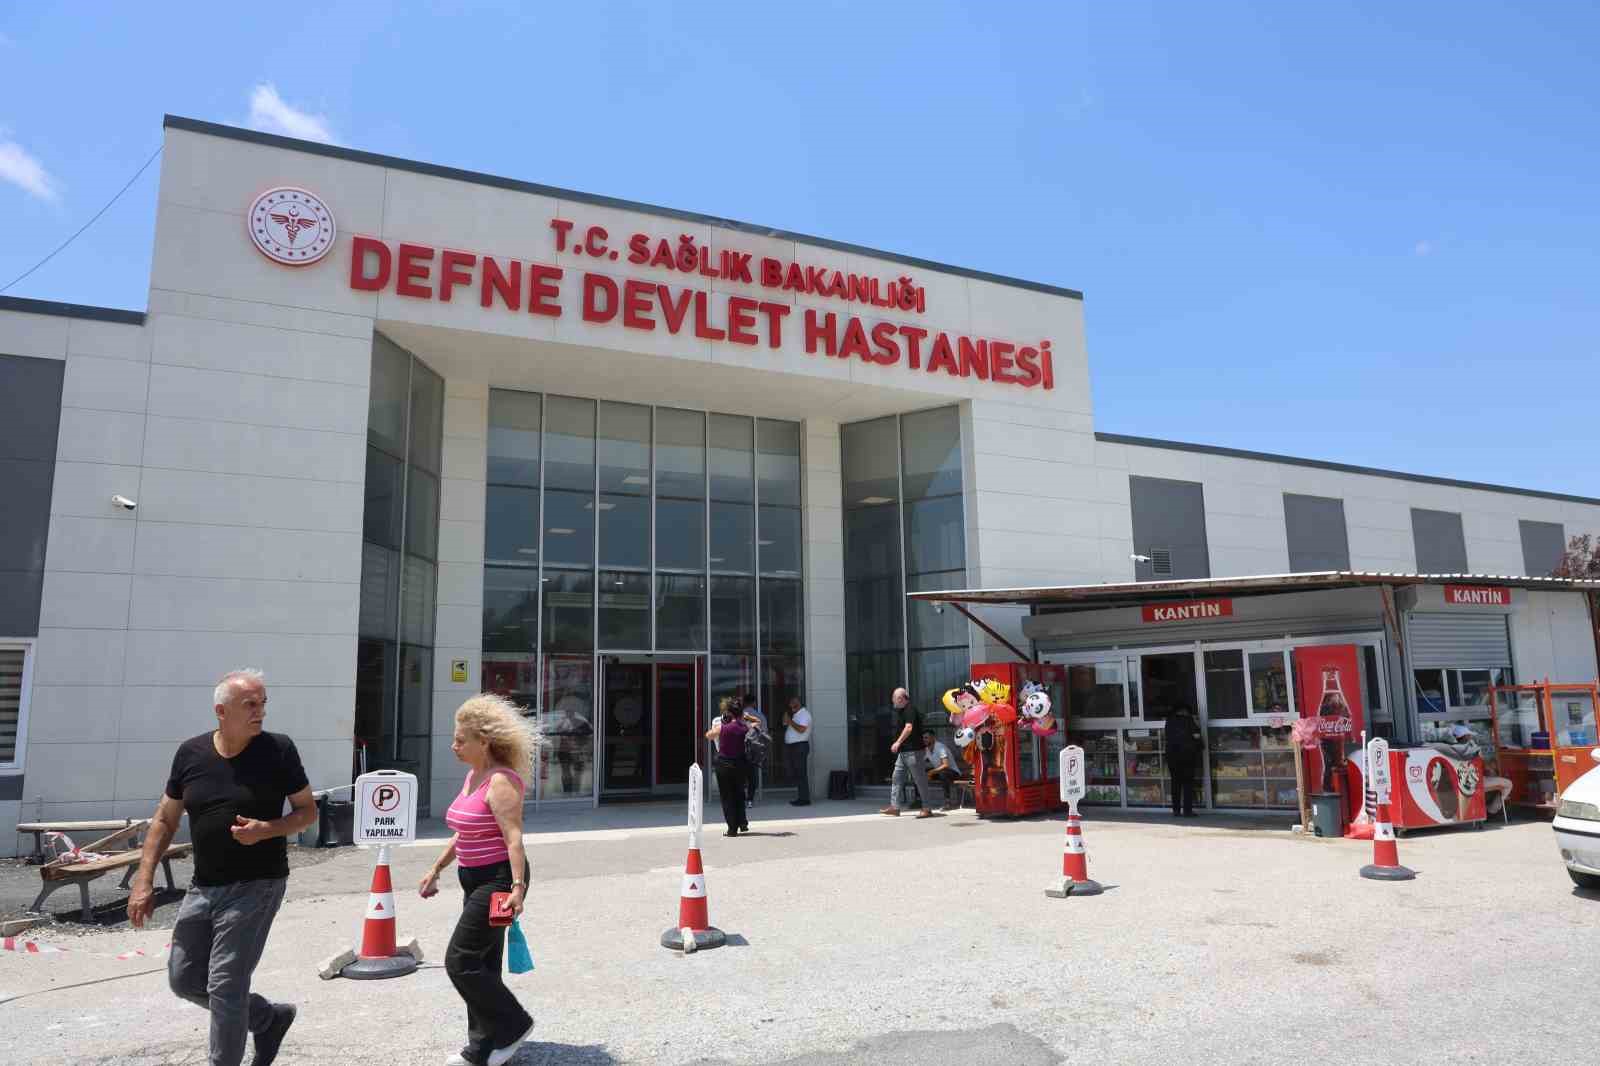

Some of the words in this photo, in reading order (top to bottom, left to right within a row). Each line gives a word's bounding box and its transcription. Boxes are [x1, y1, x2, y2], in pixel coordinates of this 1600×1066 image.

[550, 219, 619, 261] T.C.
[627, 233, 752, 284] SAĞLIK
[760, 255, 926, 314] BAKANLIĞI
[350, 235, 564, 318] DEFNE
[582, 272, 791, 350] DEVLET
[804, 308, 1055, 390] HASTANESİ
[1453, 588, 1502, 604] KANTİN
[1153, 602, 1220, 620] KANTİN
[375, 817, 395, 825] PARK
[365, 828, 403, 837] YAPILMAZ
